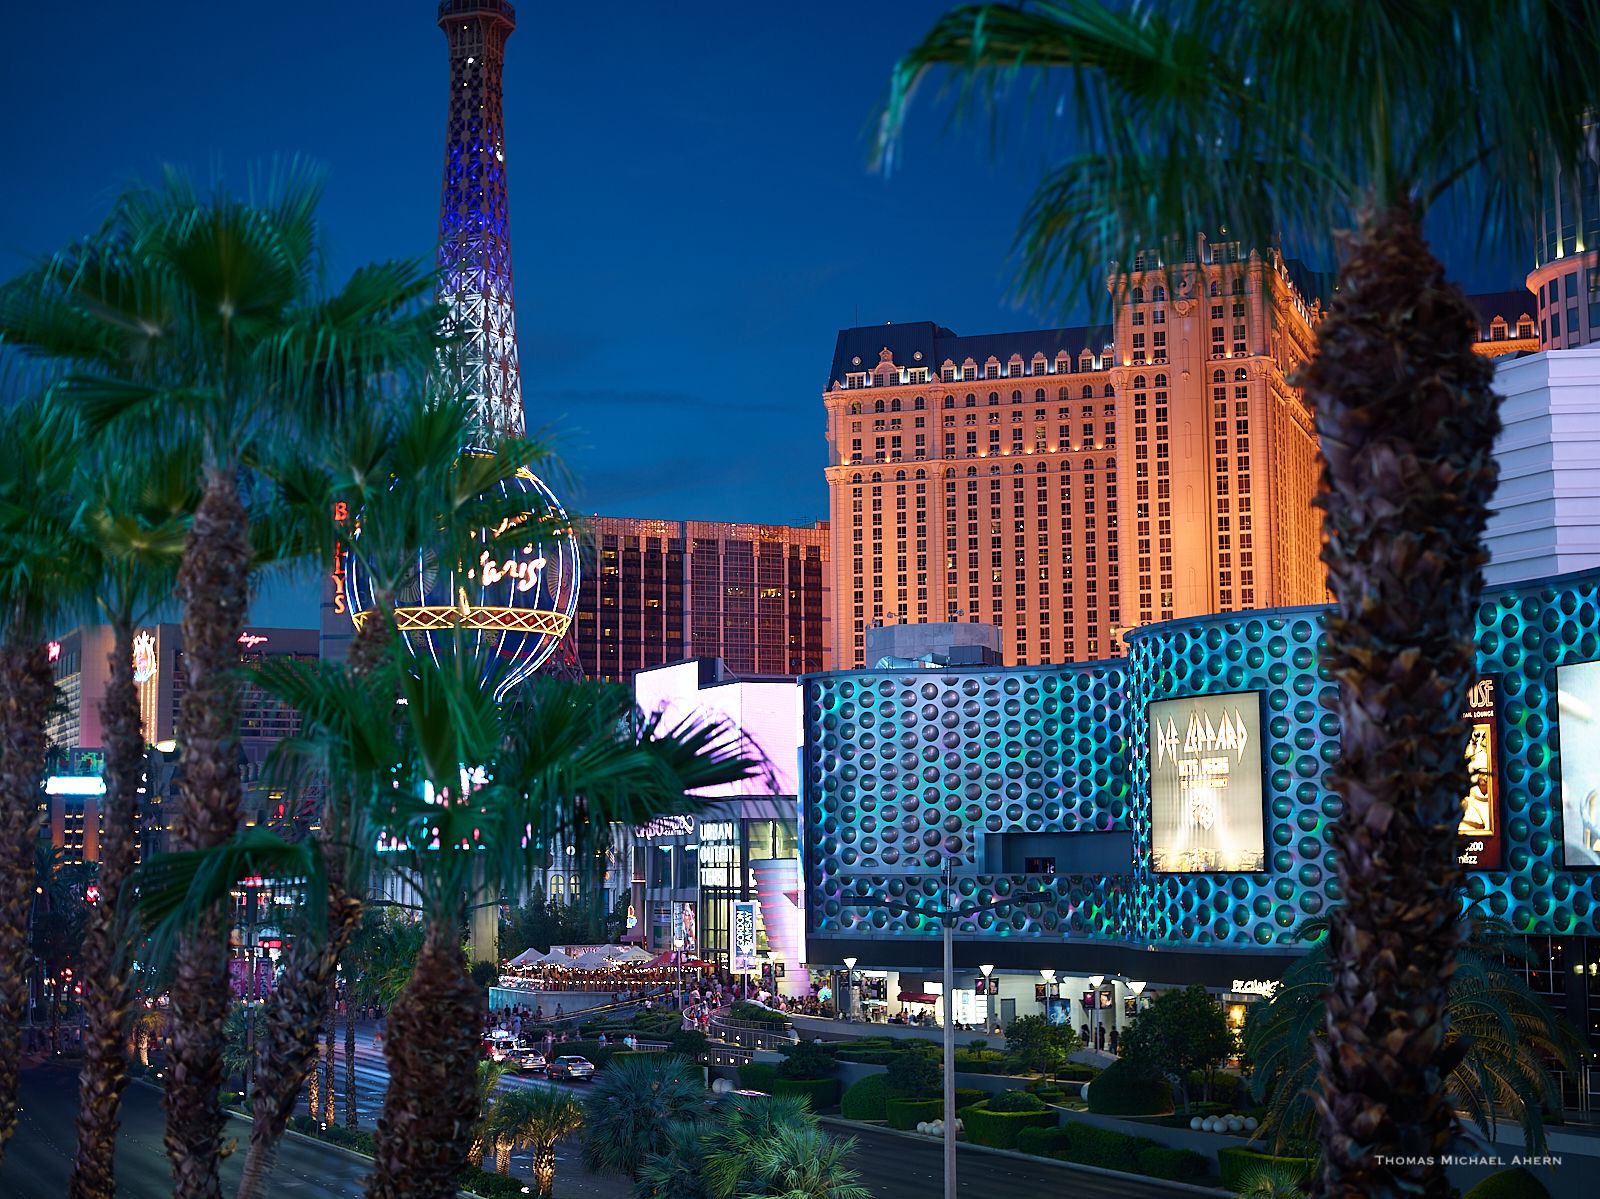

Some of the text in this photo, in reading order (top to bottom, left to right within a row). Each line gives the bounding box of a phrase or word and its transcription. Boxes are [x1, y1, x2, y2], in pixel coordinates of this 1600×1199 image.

[332, 501, 348, 614] BLLYS
[1467, 679, 1494, 708] USE
[1156, 706, 1248, 771] DEF LEPPARD
[699, 822, 733, 841] URBAN
[736, 910, 744, 947] GORDON
